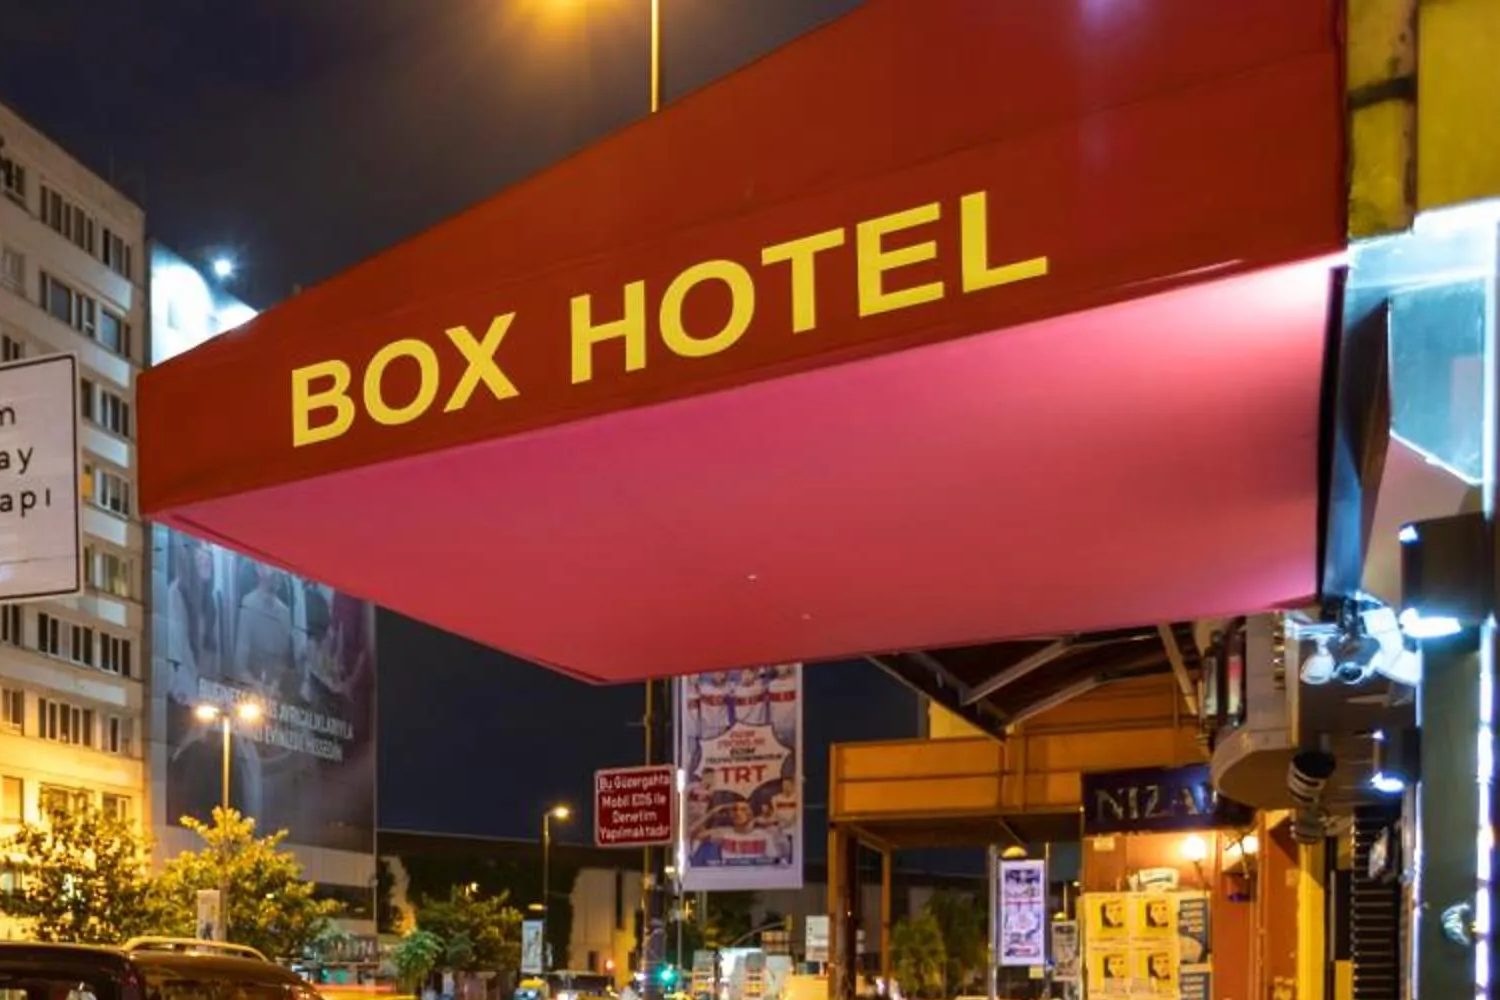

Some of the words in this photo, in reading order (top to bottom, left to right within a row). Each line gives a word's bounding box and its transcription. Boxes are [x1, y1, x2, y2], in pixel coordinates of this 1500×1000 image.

[291, 312, 520, 447] BOX
[570, 190, 1048, 385] HOTEL
[720, 764, 767, 785] TRT
